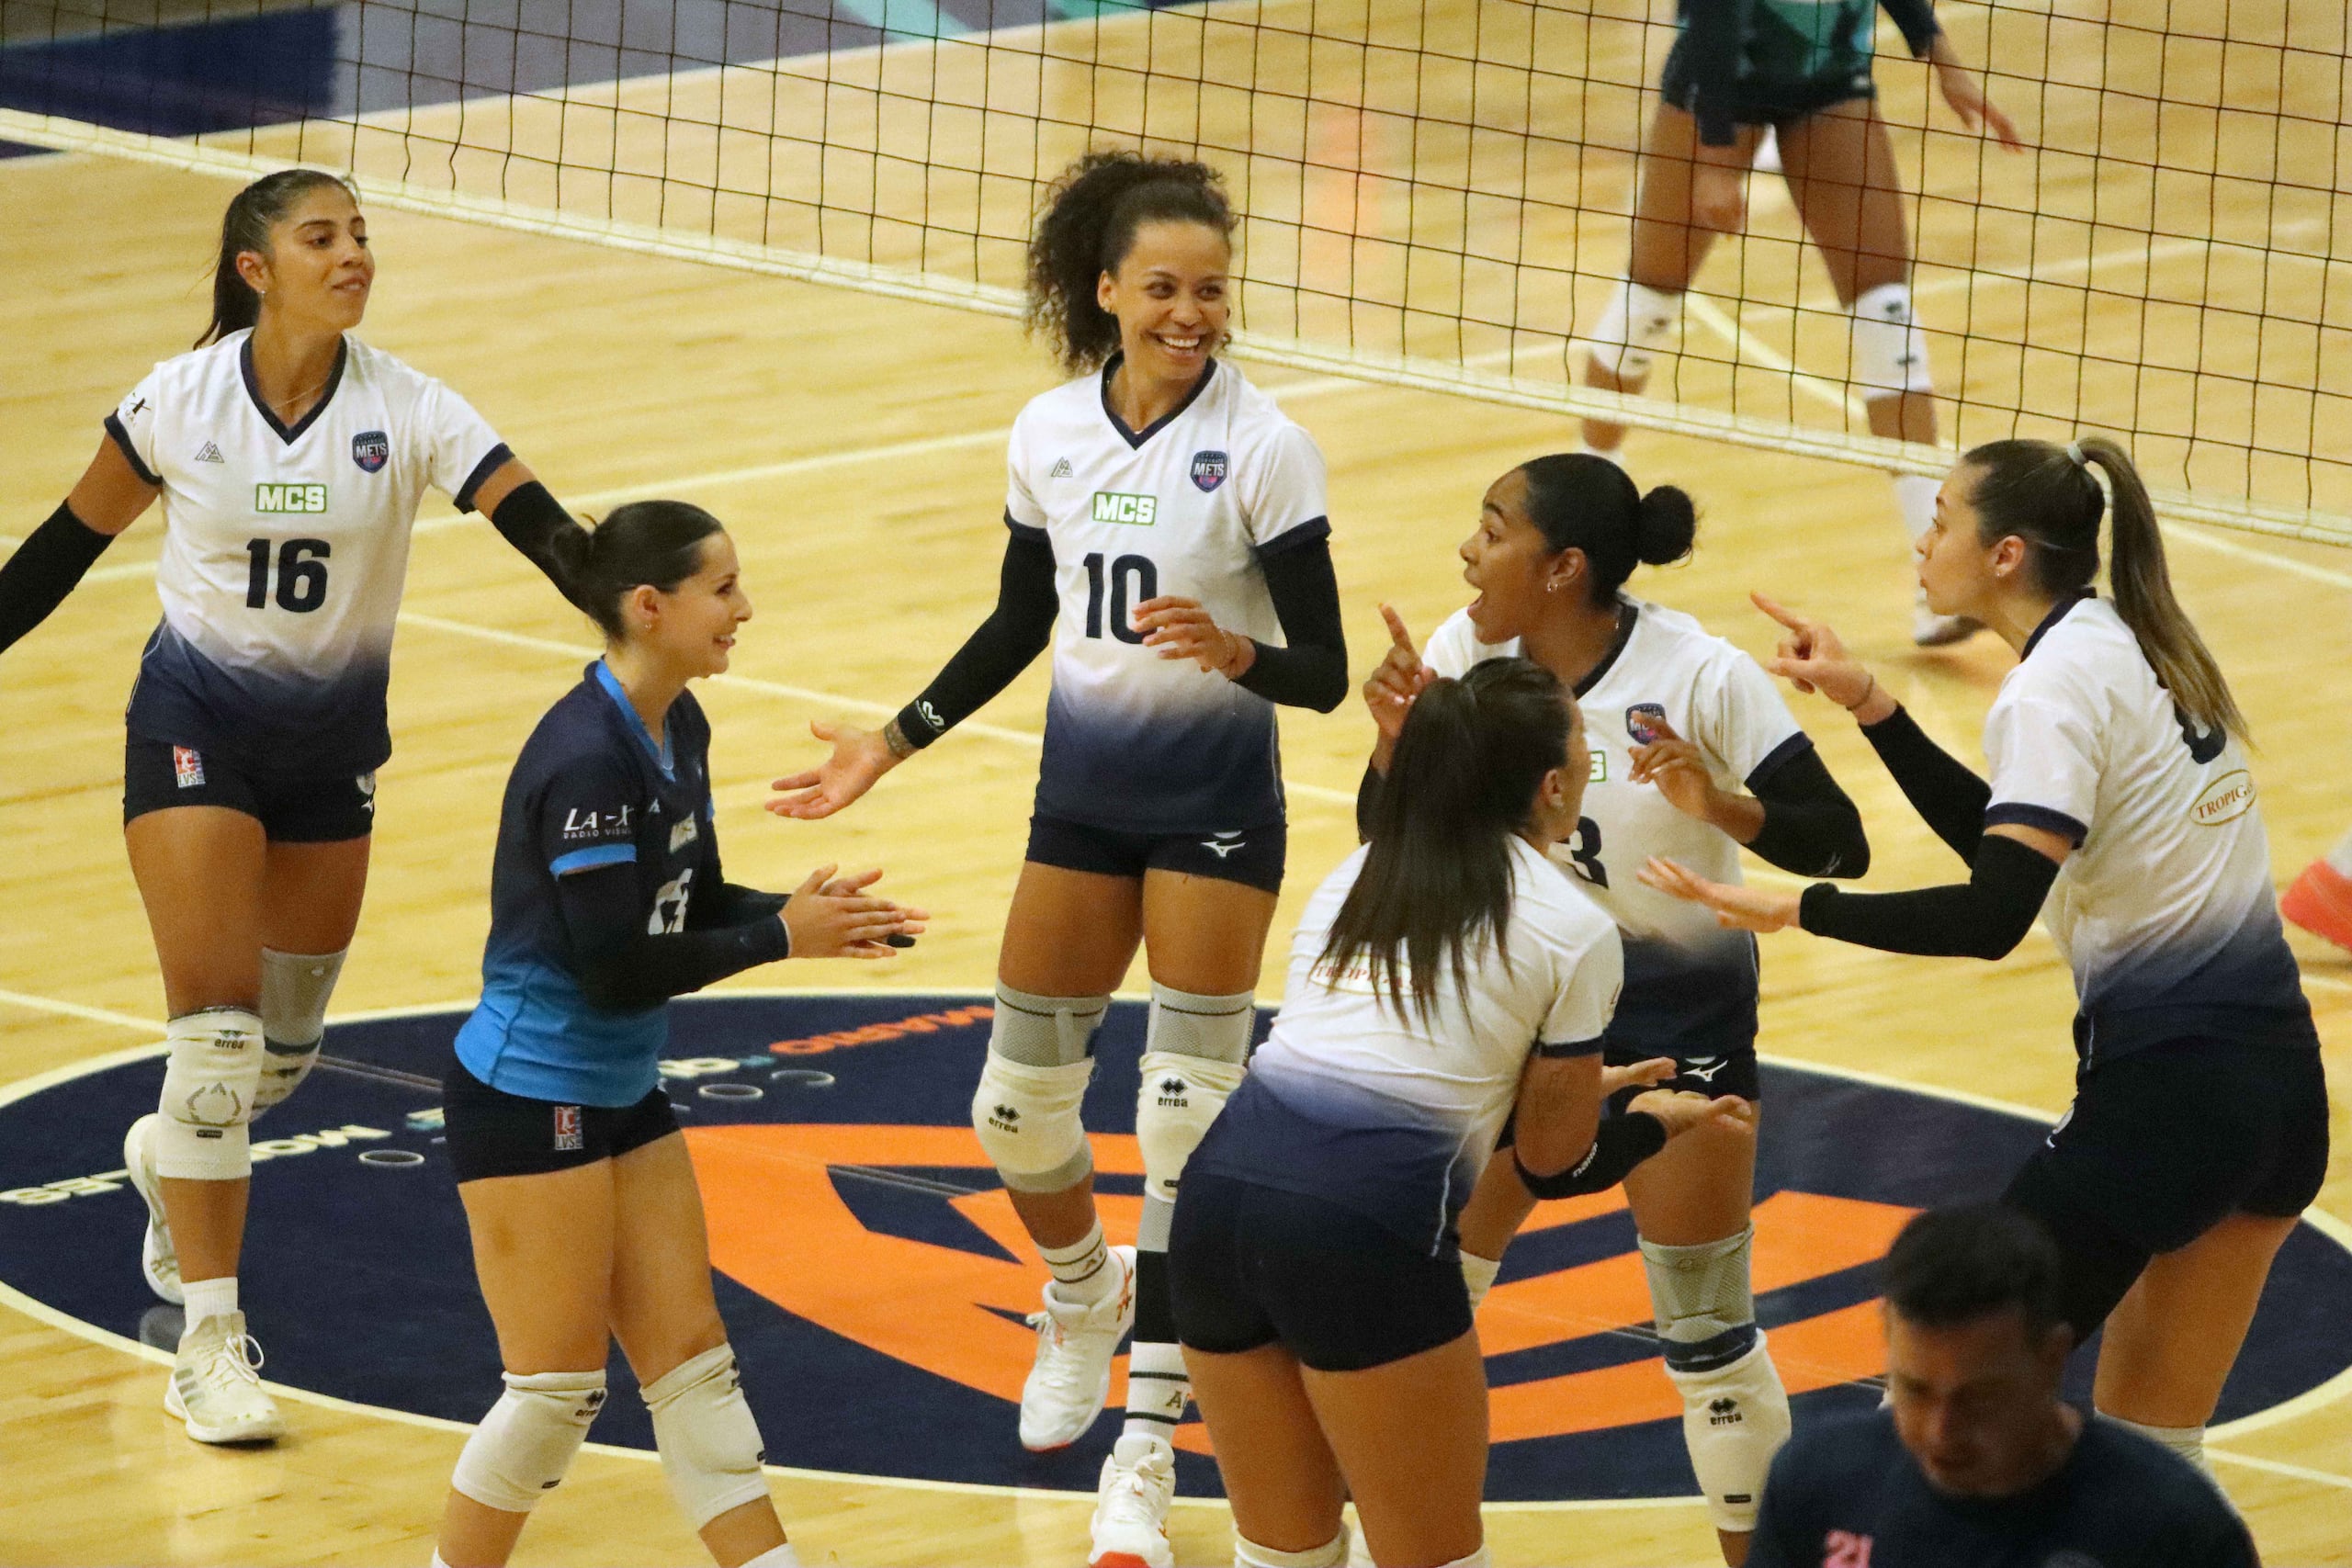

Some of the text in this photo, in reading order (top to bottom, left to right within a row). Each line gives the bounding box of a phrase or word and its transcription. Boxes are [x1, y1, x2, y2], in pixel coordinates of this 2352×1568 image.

[356, 443, 387, 458] METS
[1194, 462, 1224, 477] METS
[257, 484, 325, 513] MCS
[1094, 493, 1156, 525] MCS
[246, 537, 331, 613] 16
[1083, 552, 1158, 644] 10
[1158, 1096, 1188, 1108] errea
[989, 1116, 1019, 1134] errea
[1710, 1413, 1742, 1426] errea
